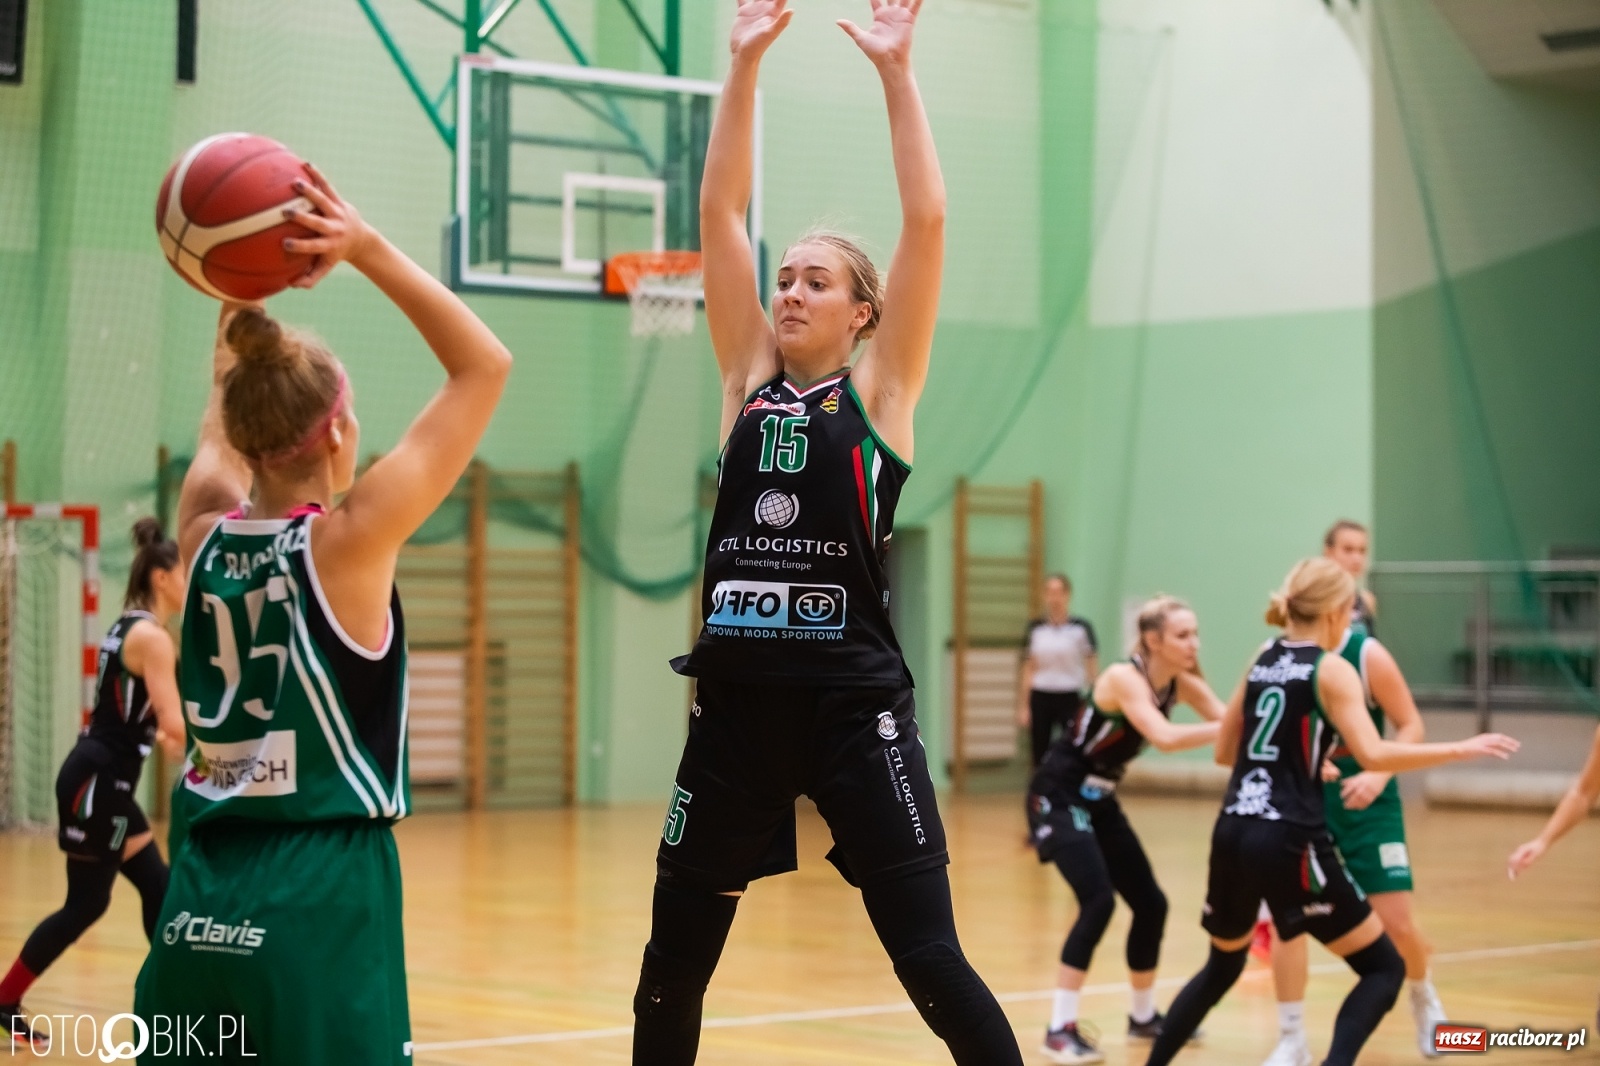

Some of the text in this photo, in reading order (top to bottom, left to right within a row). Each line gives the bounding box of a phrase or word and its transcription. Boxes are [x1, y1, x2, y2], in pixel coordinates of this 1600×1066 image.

[758, 414, 811, 473] 15
[718, 535, 848, 557] CTL LOGISTICS
[735, 557, 812, 571] Connecting Europe
[743, 629, 778, 639] MODA
[781, 630, 844, 640] SPORTOWA
[1247, 686, 1287, 762] 2
[890, 746, 927, 845] CTL LOGISTICS
[661, 781, 693, 846] 5
[109, 816, 128, 851] 7
[184, 916, 267, 947] Clavis
